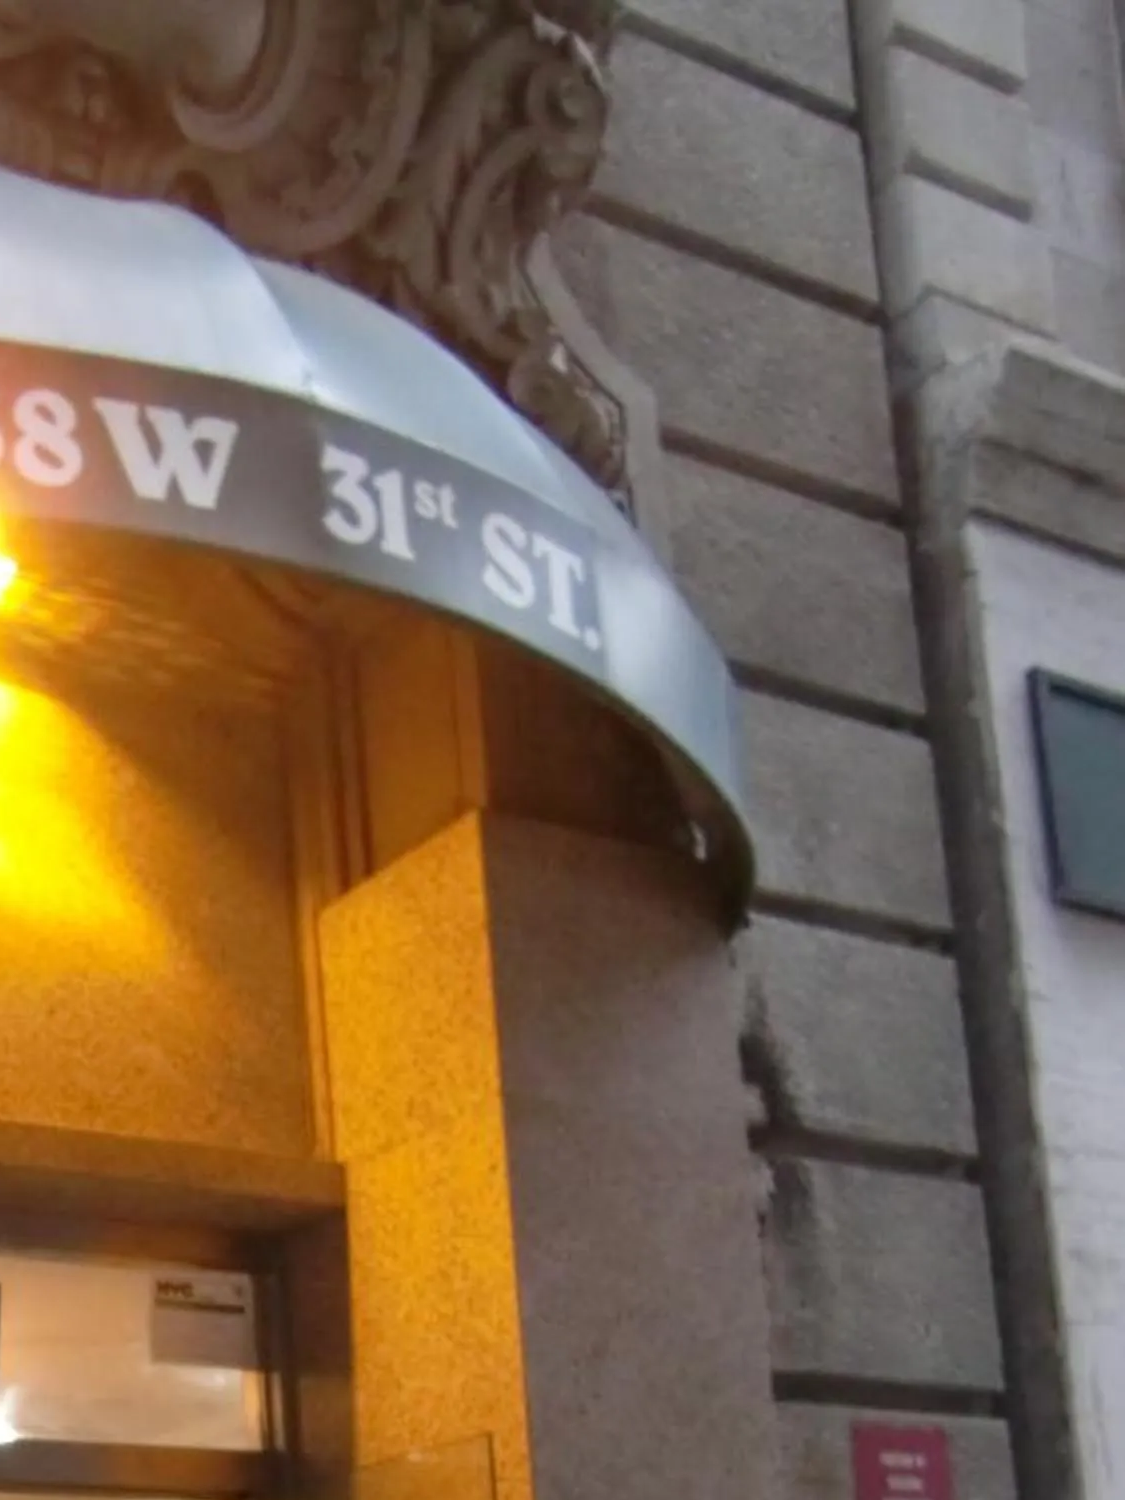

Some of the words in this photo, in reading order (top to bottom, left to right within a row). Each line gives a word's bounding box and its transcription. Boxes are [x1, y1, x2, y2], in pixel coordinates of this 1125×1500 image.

[92, 396, 240, 511] W
[318, 442, 460, 563] 31st
[480, 511, 602, 652] ST.
